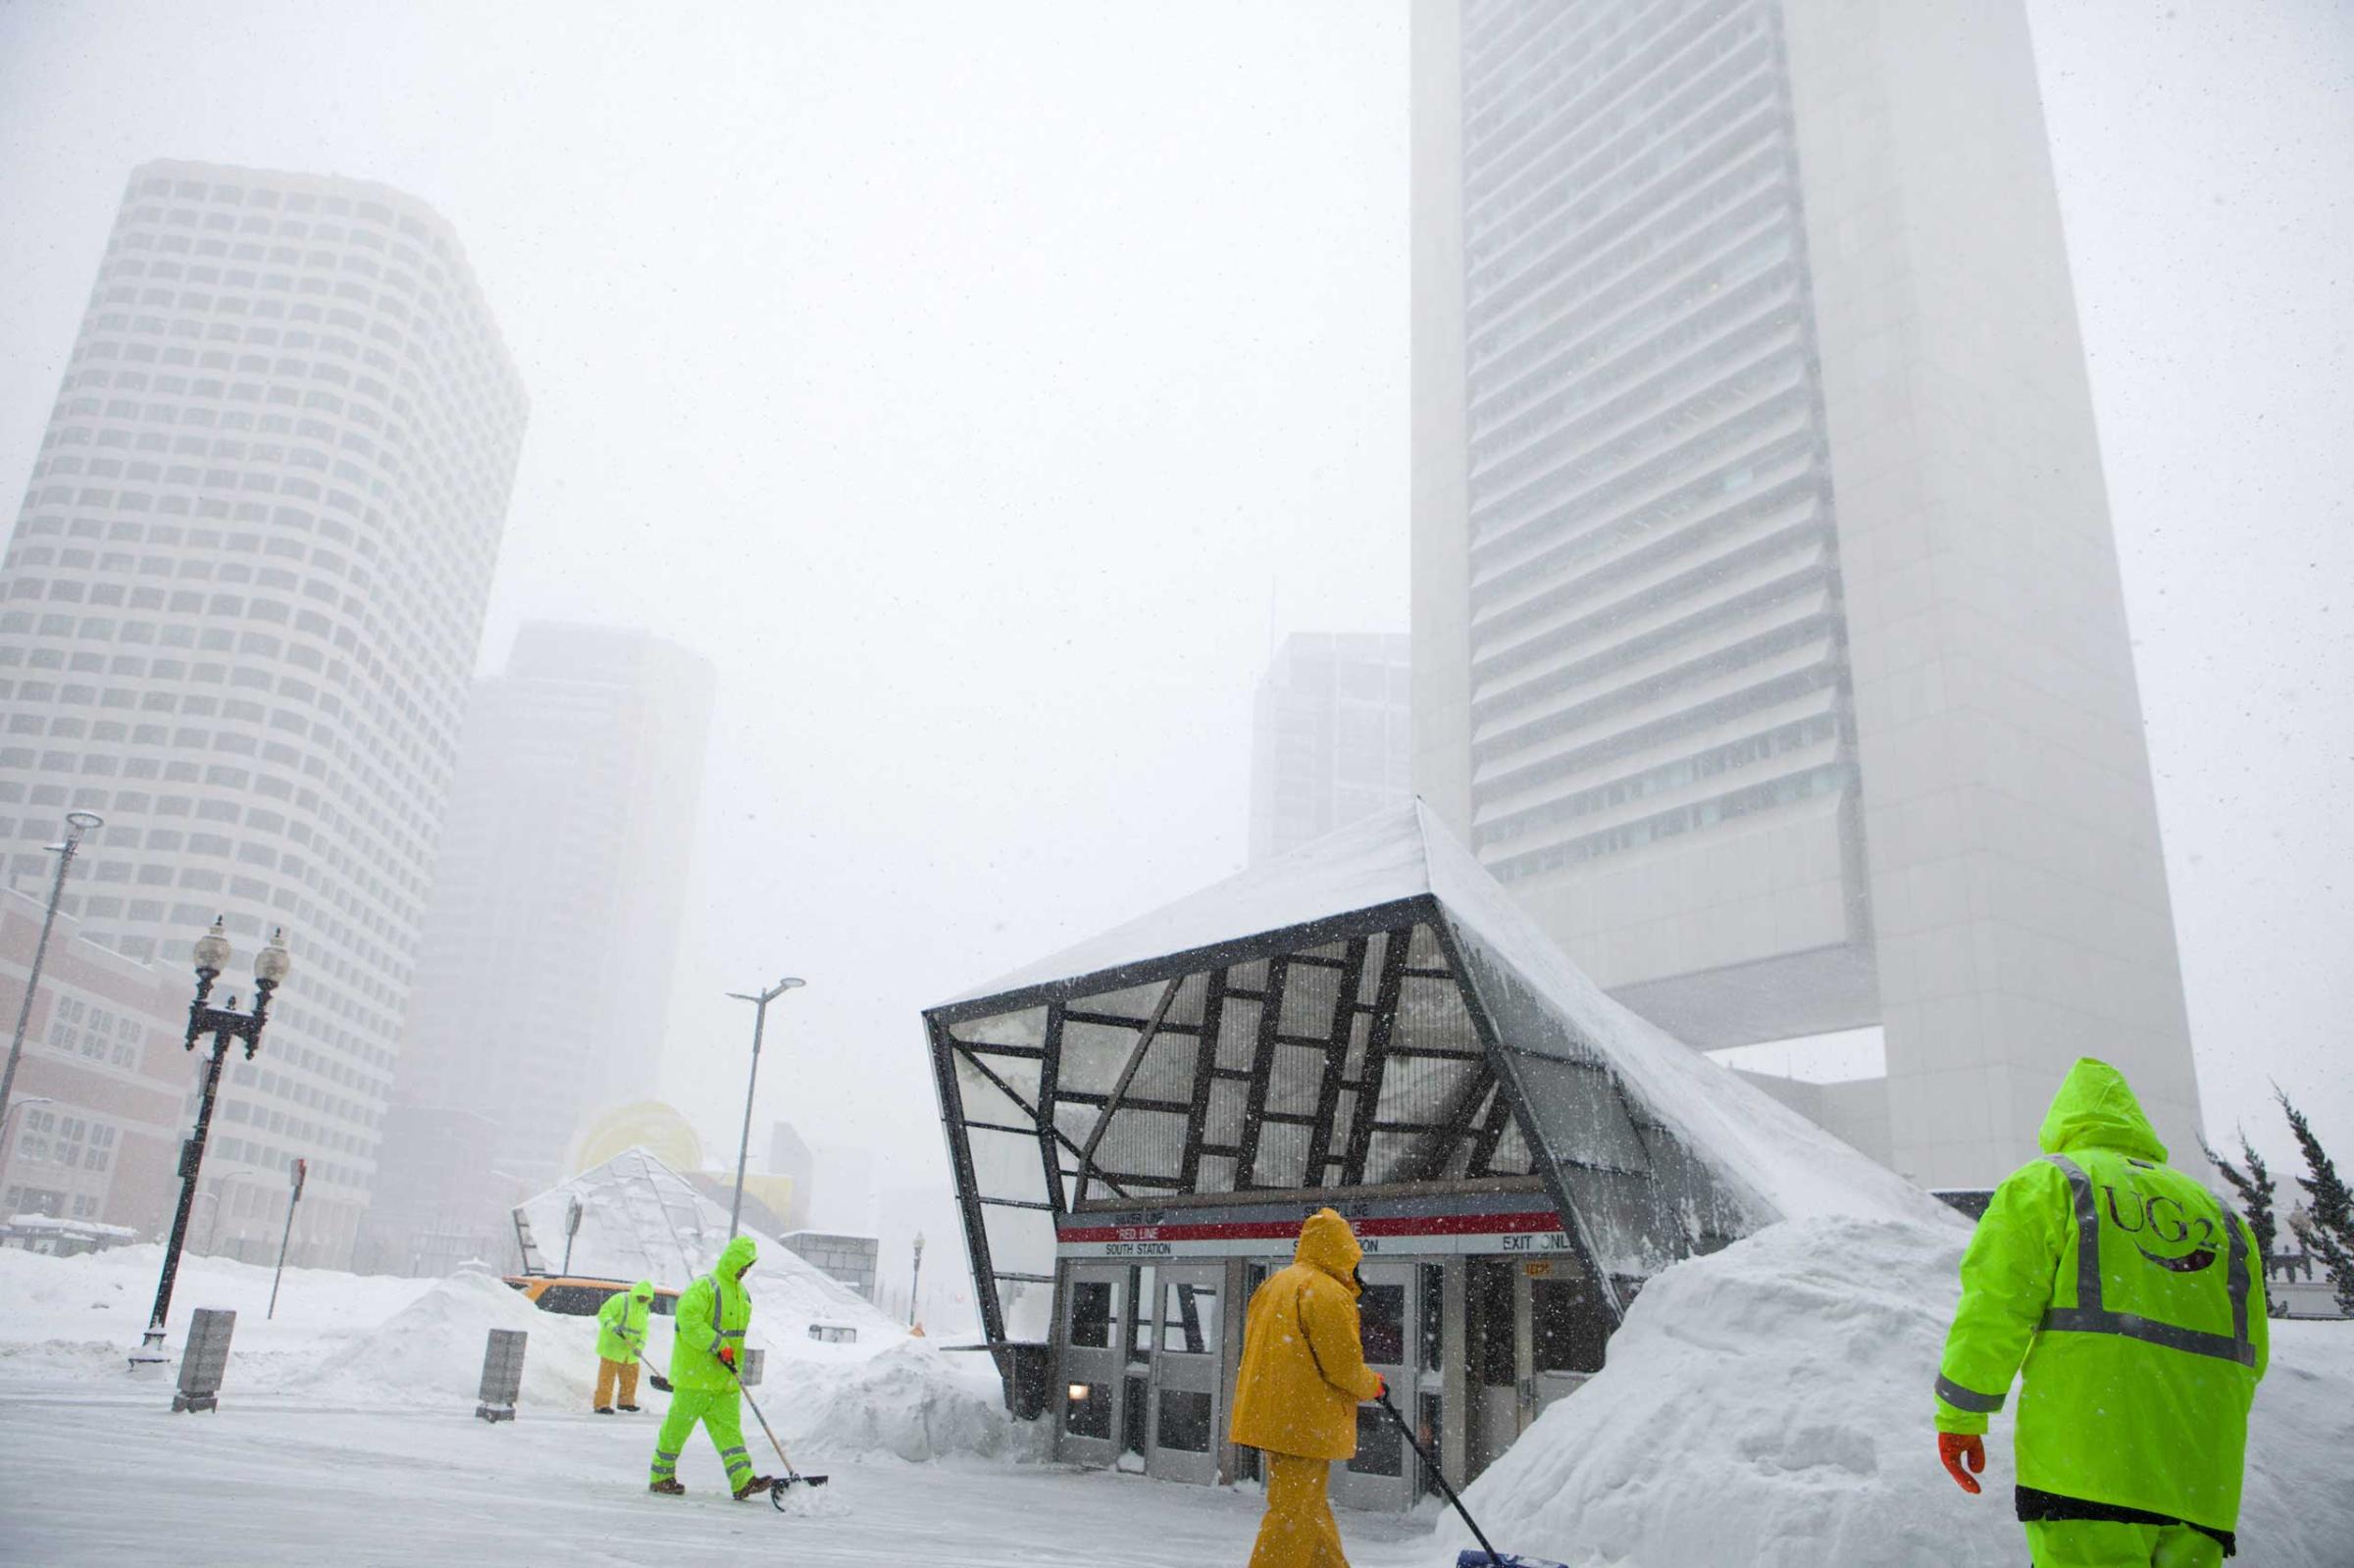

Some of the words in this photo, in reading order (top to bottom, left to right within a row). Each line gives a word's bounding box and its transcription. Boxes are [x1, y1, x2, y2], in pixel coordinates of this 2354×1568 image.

[1146, 1212, 1164, 1224] LINE
[2100, 1185, 2219, 1249] UG2
[1119, 1228, 1136, 1239] RED
[1139, 1228, 1158, 1239] LINE
[1106, 1243, 1134, 1255] SOUTH
[1136, 1242, 1171, 1254] STATION
[1503, 1236, 1532, 1250] EXIT
[1540, 1234, 1573, 1249] ONL
